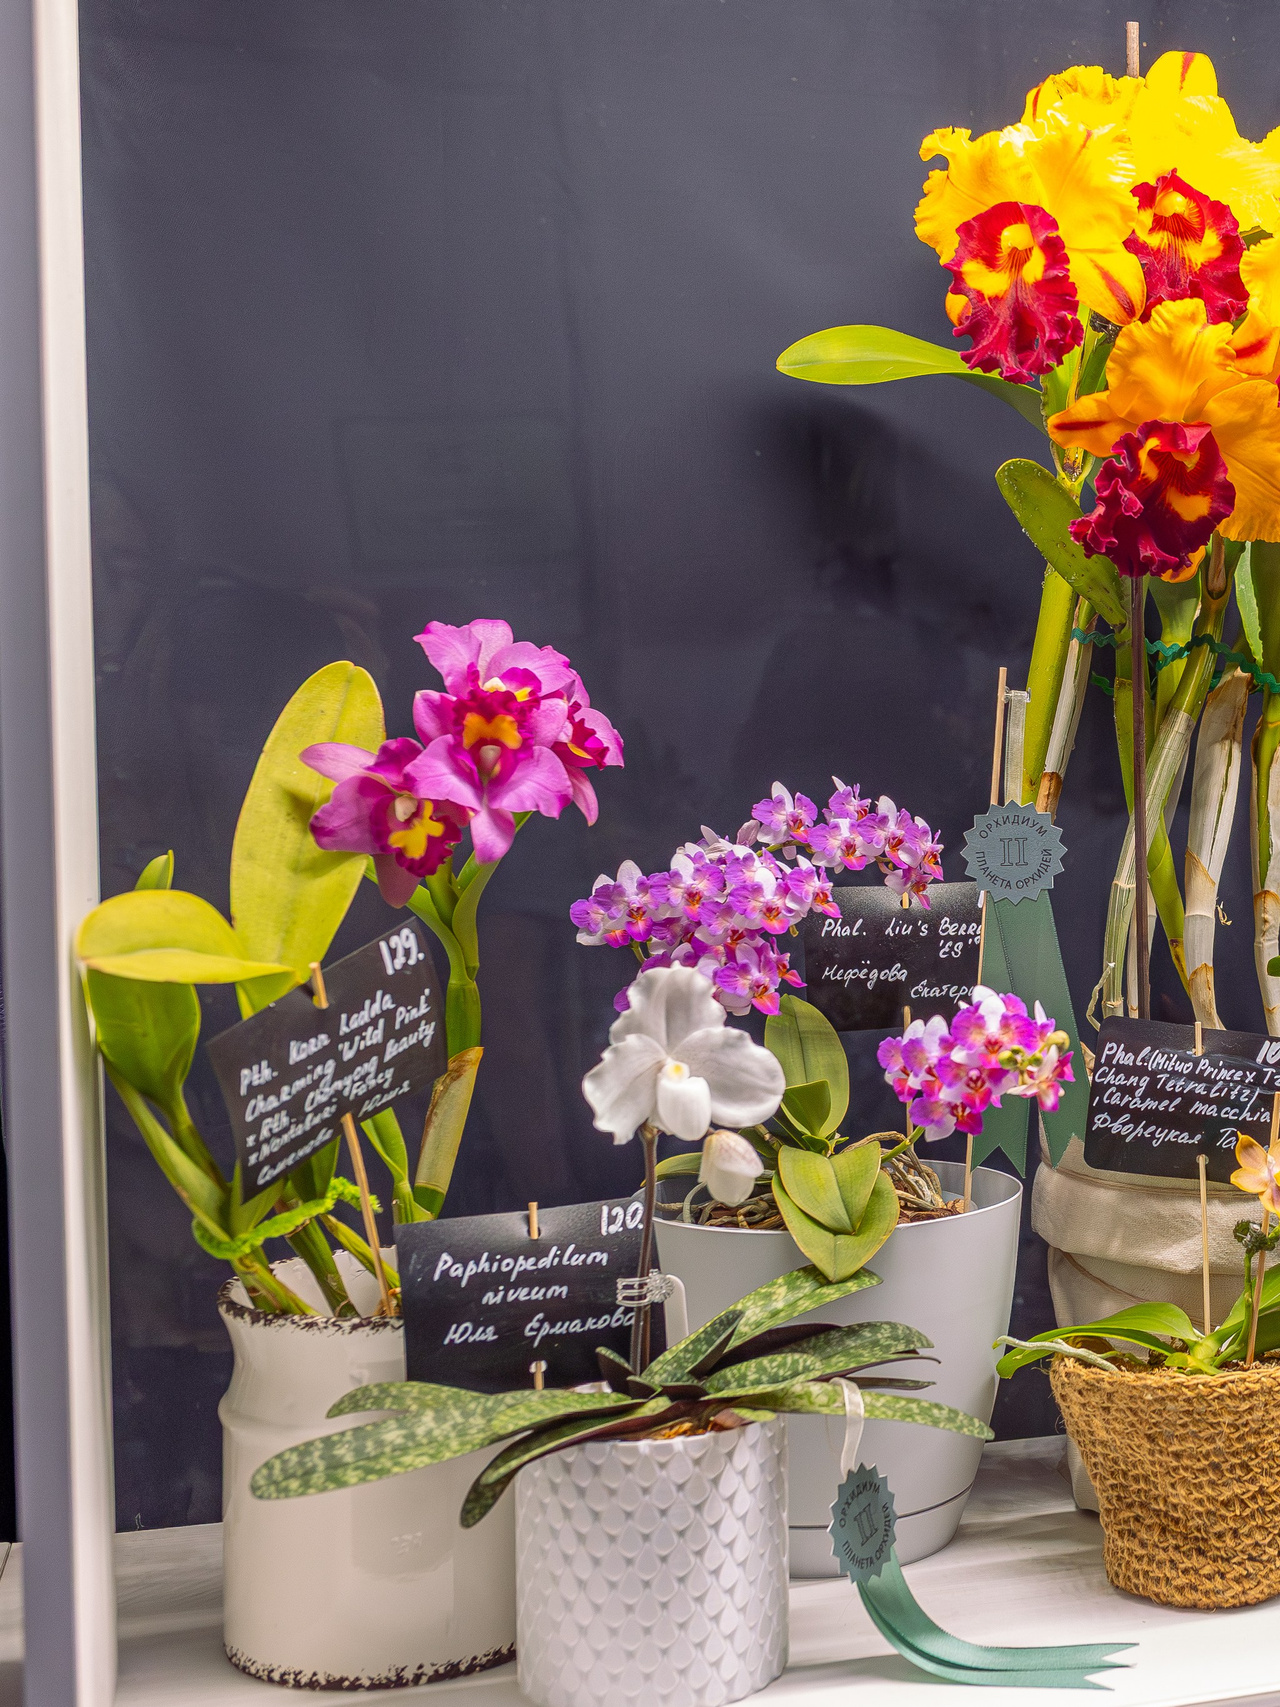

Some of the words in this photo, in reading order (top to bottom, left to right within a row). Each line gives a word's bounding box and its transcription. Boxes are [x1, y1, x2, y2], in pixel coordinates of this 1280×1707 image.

[979, 814, 1048, 839] ОРХИДИУМ
[999, 837, 1029, 867] II
[975, 851, 1012, 890] ПЛАНЕТА
[1015, 848, 1052, 889] ОРХИДЕЙ
[821, 918, 867, 937] Phal.
[885, 920, 929, 937] Liu's
[1094, 1066, 1150, 1097] Chang
[433, 1244, 608, 1287] Paphiopedilum
[482, 1285, 568, 1305] niveum
[839, 1480, 880, 1528] ОРХИДИУМ
[842, 1540, 875, 1570] ПЛАНЕТА
